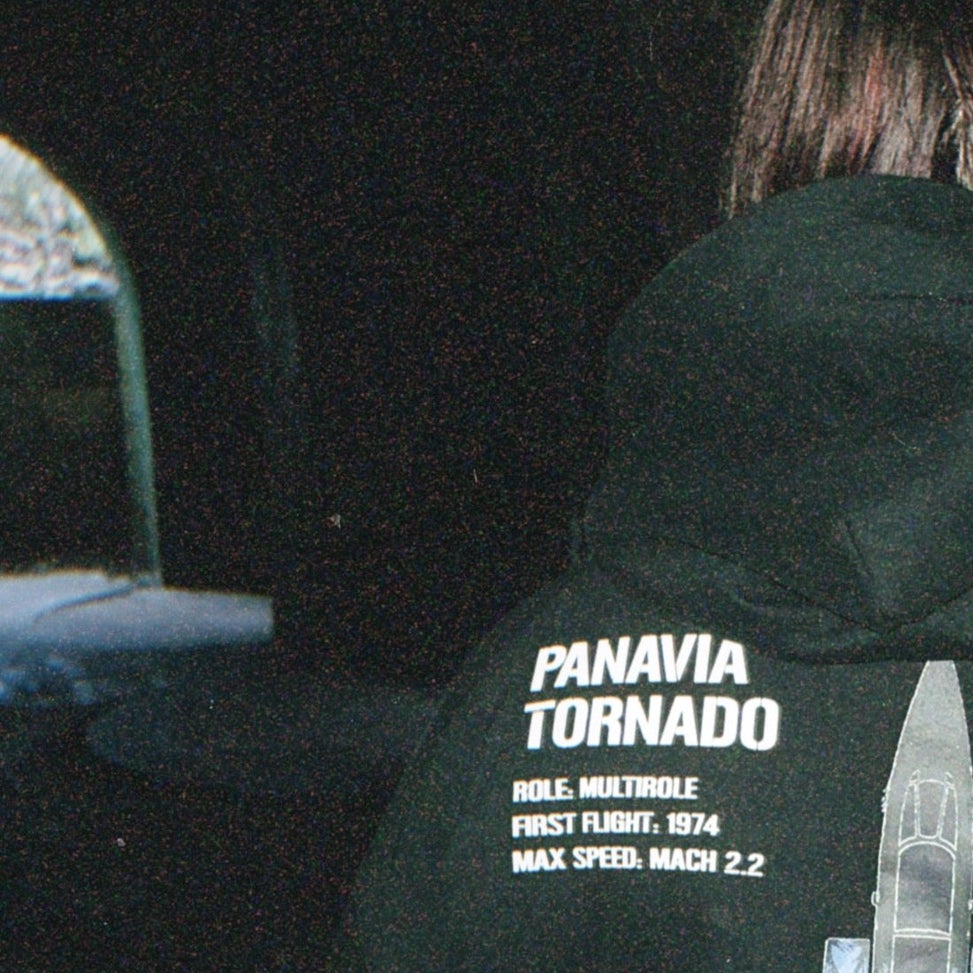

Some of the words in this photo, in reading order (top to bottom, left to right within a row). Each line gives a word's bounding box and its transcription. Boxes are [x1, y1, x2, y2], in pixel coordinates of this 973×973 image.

[530, 633, 749, 692] PANAVIA
[524, 695, 780, 751] TORNADO
[513, 778, 574, 802] ROLE:
[579, 775, 699, 799] MULTIROLE
[512, 812, 577, 837] FIRST
[582, 811, 659, 834] FLIGHT:
[666, 812, 720, 836] 1974
[512, 848, 566, 873] MAX
[572, 846, 643, 869] SPEED:
[649, 847, 718, 872] MACH
[724, 851, 765, 877] 2.2
